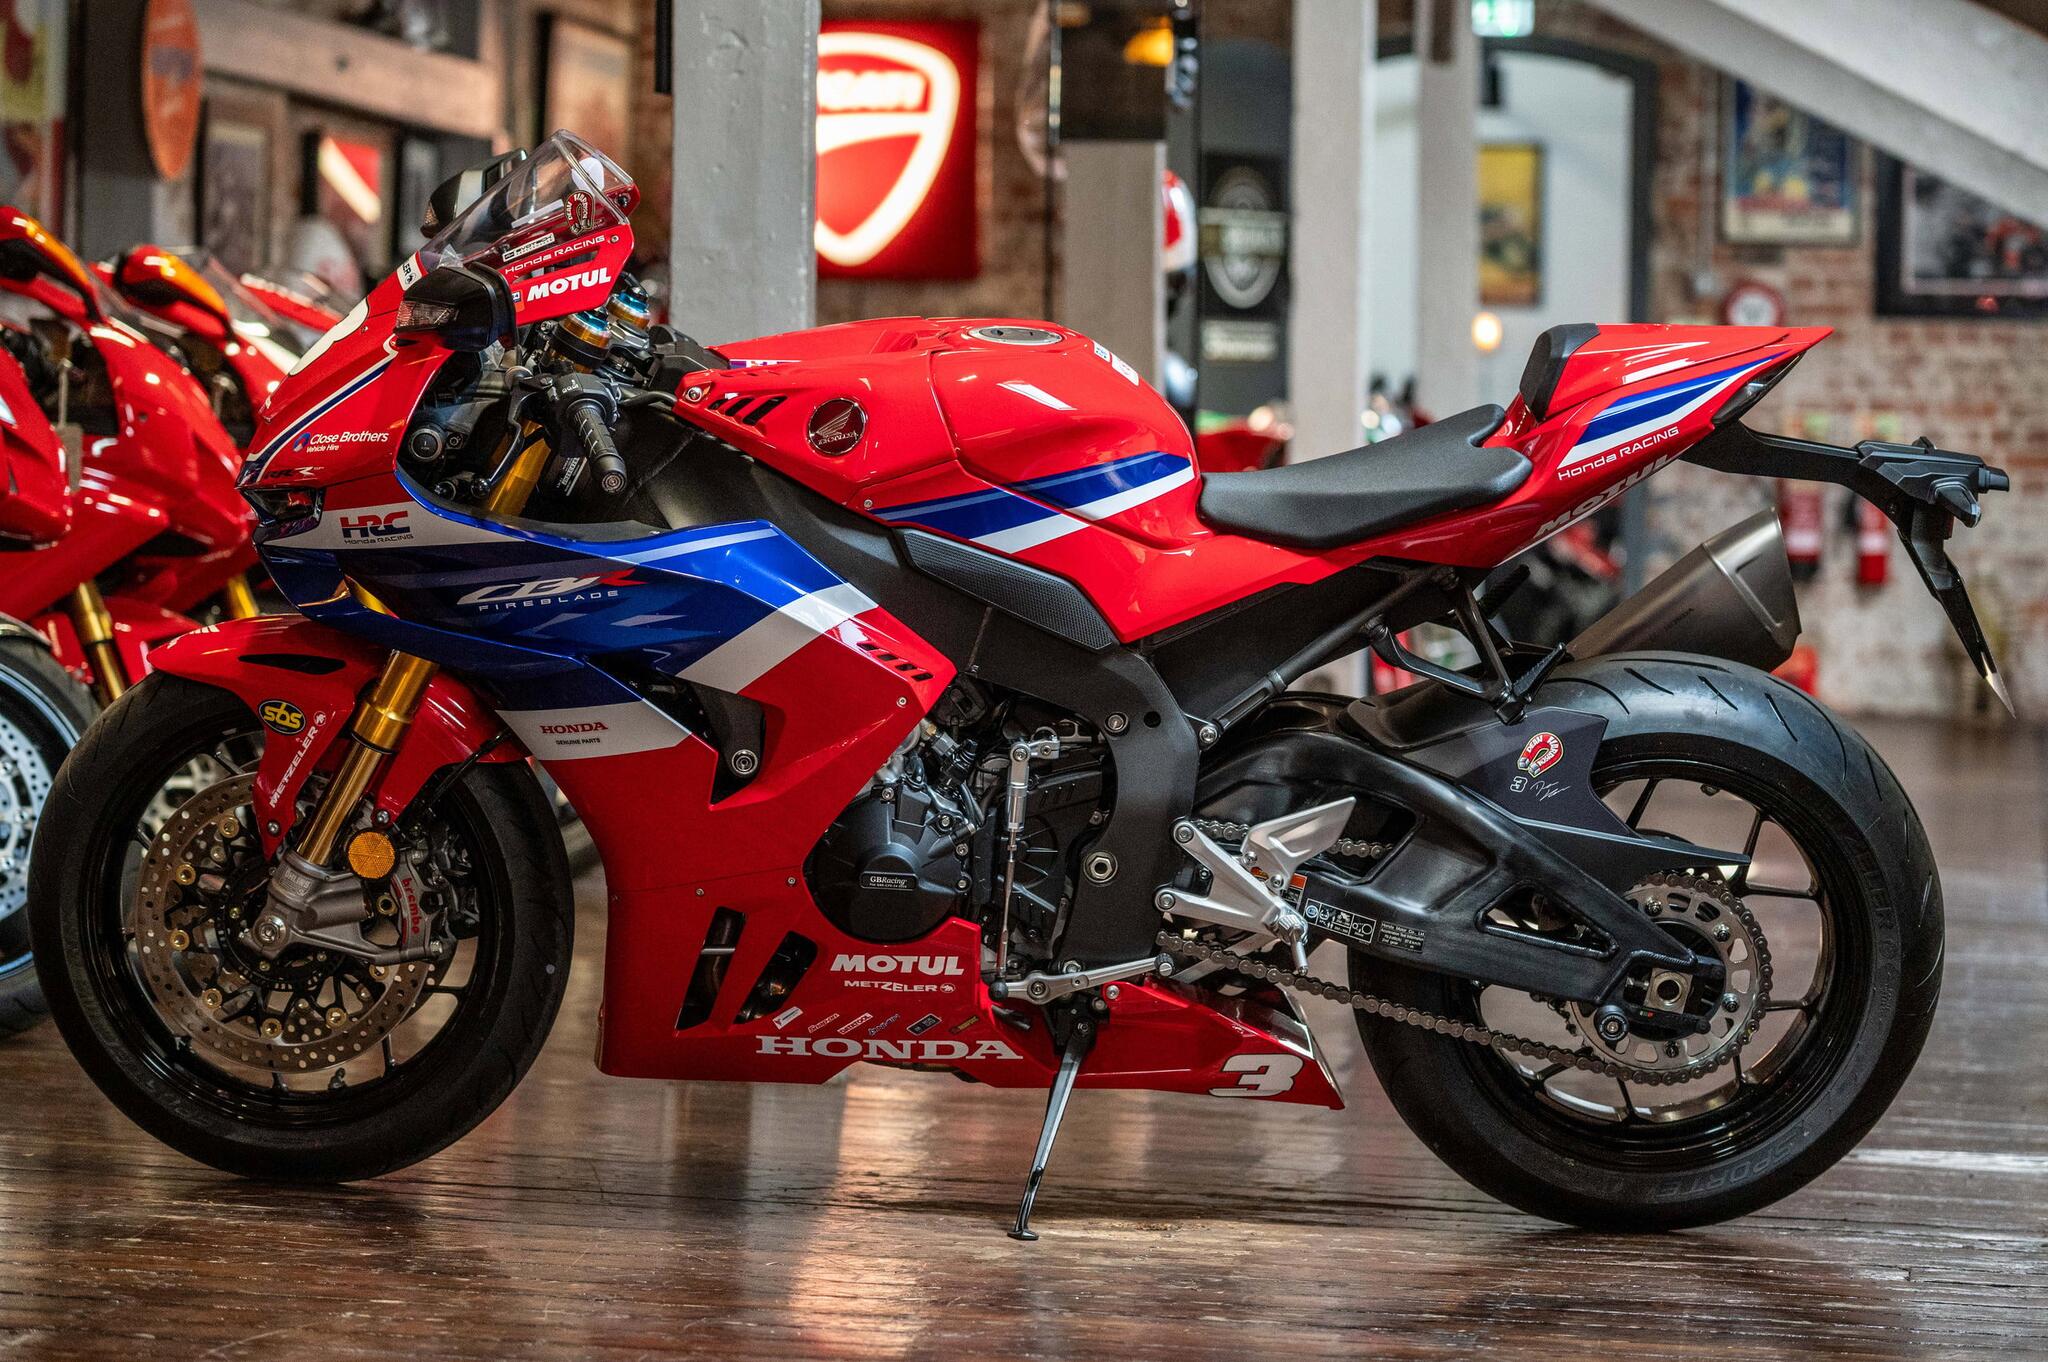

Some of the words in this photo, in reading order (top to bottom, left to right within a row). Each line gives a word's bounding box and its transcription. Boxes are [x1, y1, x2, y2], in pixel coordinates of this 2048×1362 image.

[505, 254, 552, 275] Honda
[554, 235, 606, 257] RACING
[527, 267, 612, 302] MOTUL
[310, 433, 339, 446] Close
[339, 430, 390, 443] Brothers
[1558, 453, 1617, 481] Honda
[1619, 426, 1681, 458] RACING
[1533, 454, 1669, 540] MOTUL
[340, 511, 411, 539] HRC
[344, 537, 376, 545] Honda
[376, 533, 414, 544] RACING
[478, 589, 619, 612] FIREBLADE
[263, 703, 303, 730] sbs
[540, 721, 609, 734] HONDA
[269, 725, 319, 809] METZELER
[401, 878, 422, 935] brembo
[830, 954, 966, 976] MOTUL
[844, 980, 939, 993] METZELER
[756, 1035, 1024, 1060] HONDA
[1209, 1053, 1304, 1097] 3
